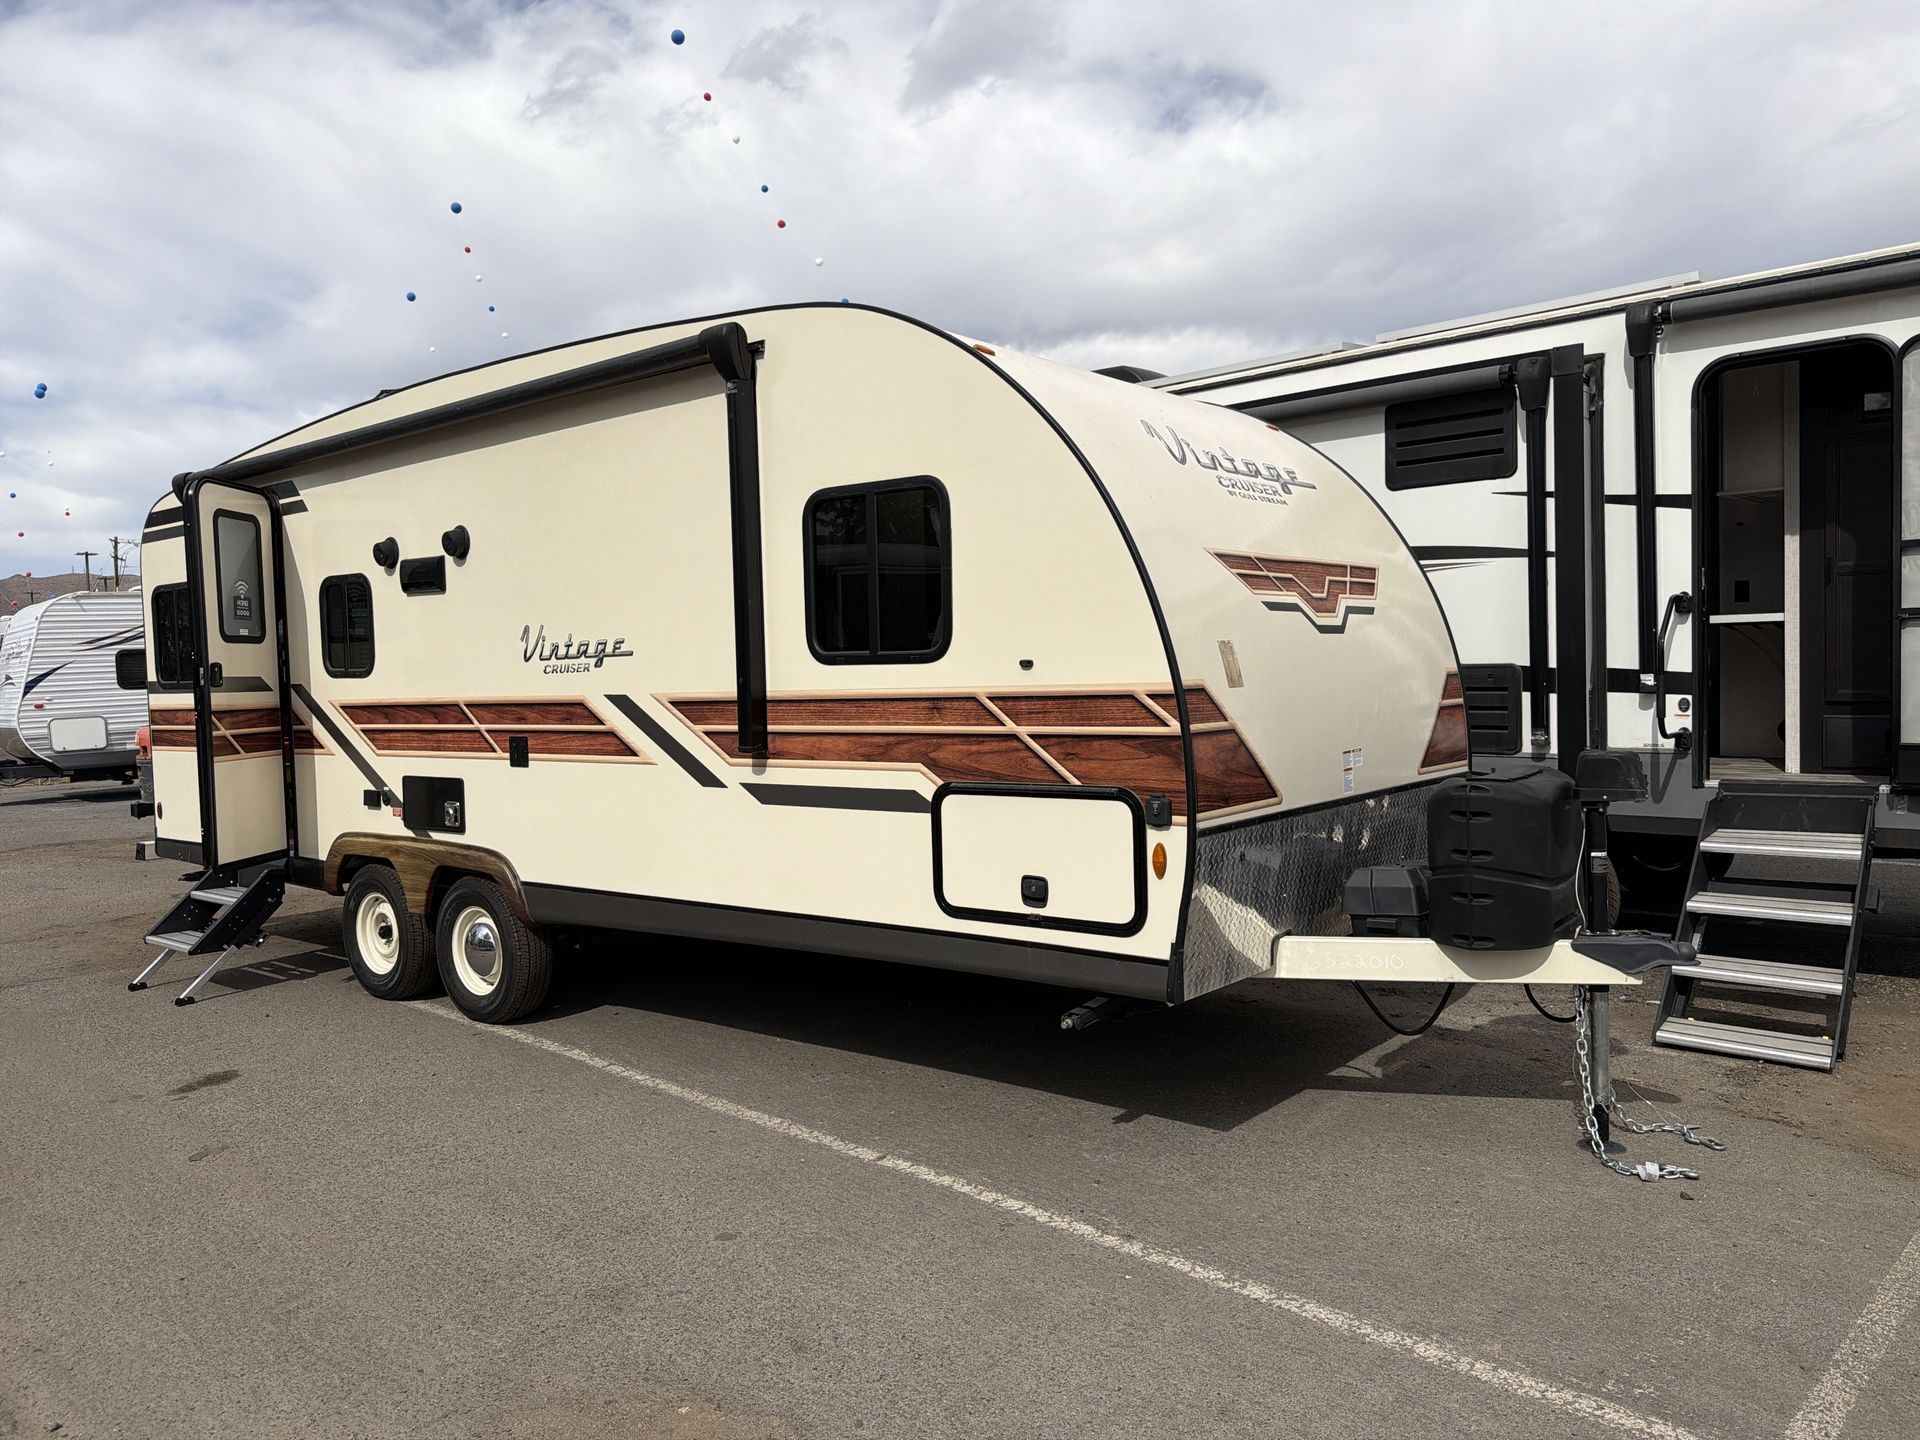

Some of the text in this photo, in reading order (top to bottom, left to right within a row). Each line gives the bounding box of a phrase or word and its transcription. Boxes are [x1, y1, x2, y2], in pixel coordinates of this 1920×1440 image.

[1140, 419, 1317, 495] Vintage
[1216, 475, 1283, 498] CRUISER
[1258, 495, 1289, 506] STREAM
[520, 624, 634, 668] Vintage
[543, 662, 591, 675] CRUISER
